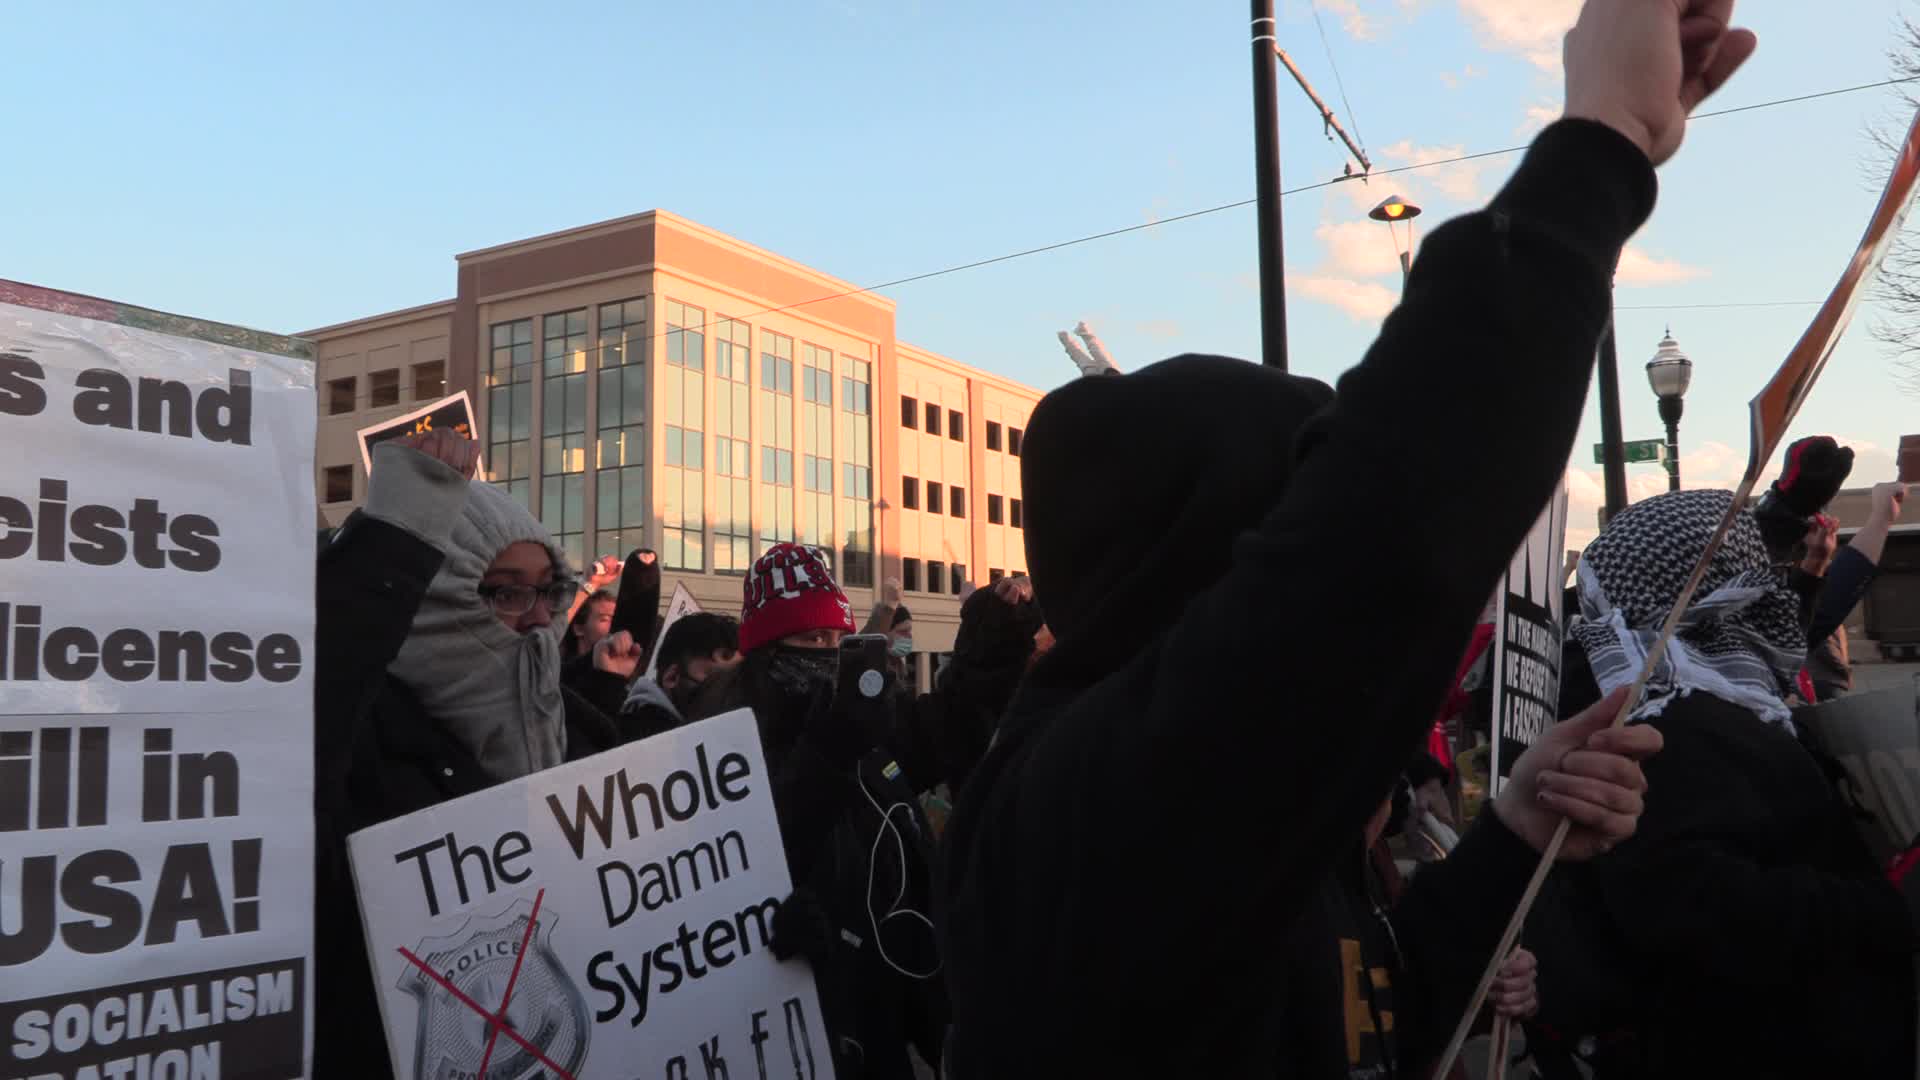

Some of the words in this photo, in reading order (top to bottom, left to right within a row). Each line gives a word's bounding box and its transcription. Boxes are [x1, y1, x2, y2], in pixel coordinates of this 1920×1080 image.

[73, 367, 252, 446] and
[142, 728, 240, 823] in
[394, 829, 533, 918] The
[545, 742, 751, 861] Whole
[0, 838, 263, 966] USA!
[596, 829, 750, 929] Damn
[443, 940, 523, 984] POLICE
[586, 898, 783, 1029] System
[12, 969, 294, 1060] SOCIALISM
